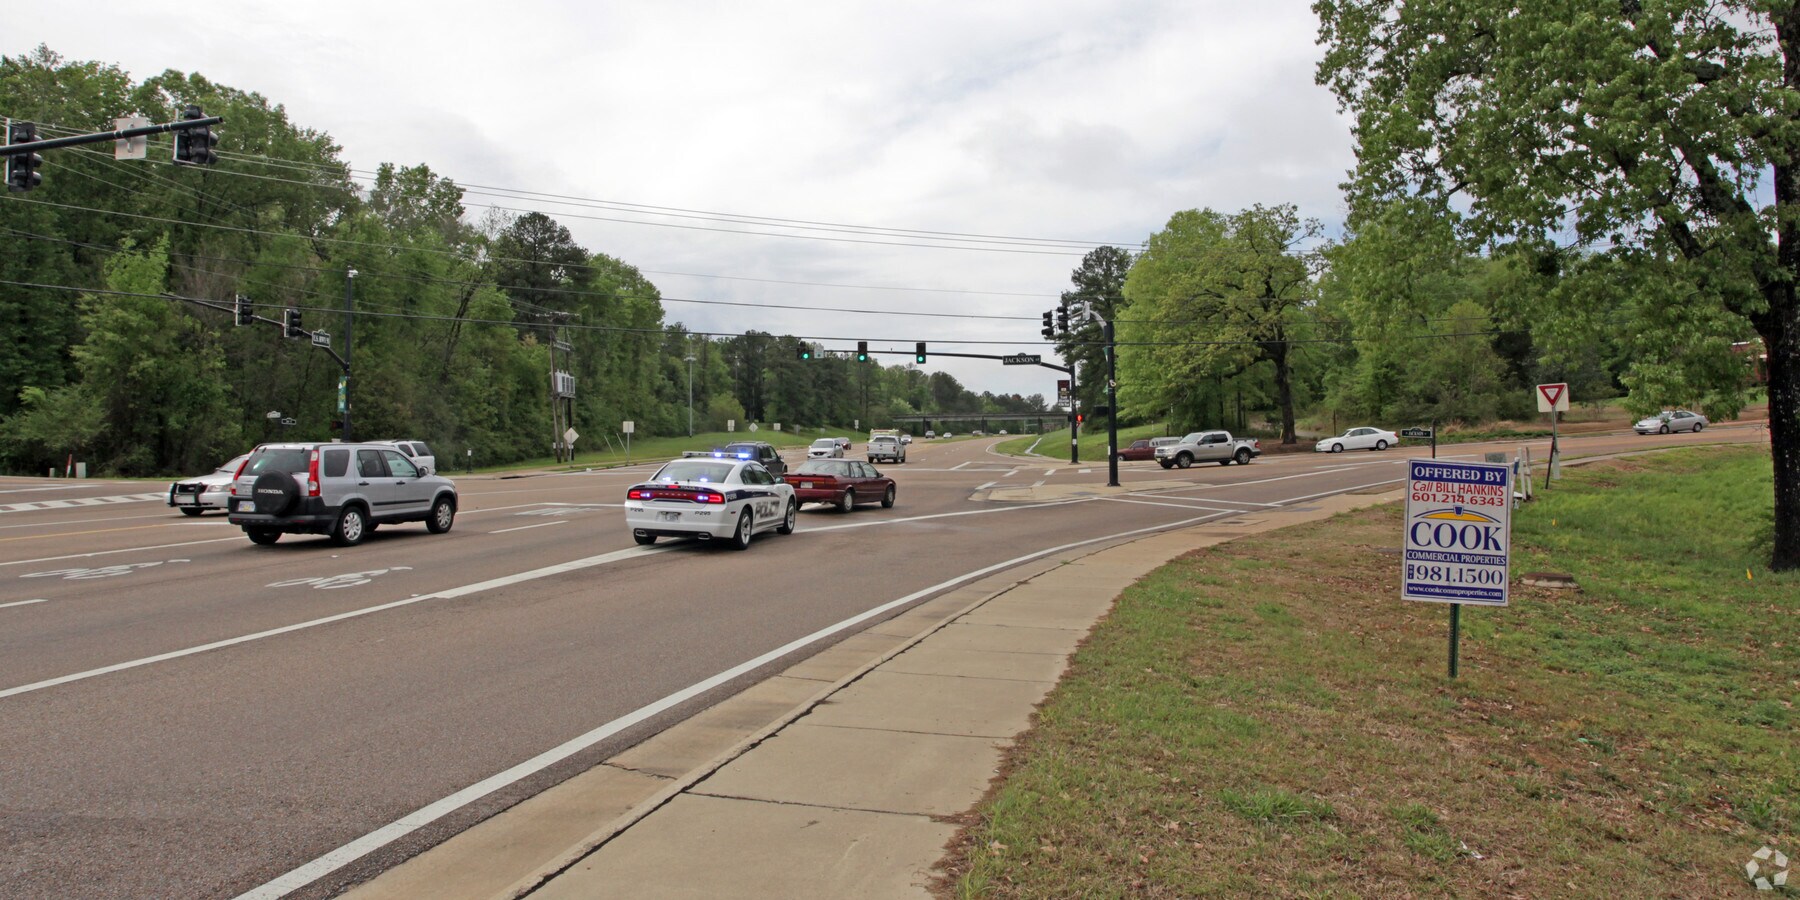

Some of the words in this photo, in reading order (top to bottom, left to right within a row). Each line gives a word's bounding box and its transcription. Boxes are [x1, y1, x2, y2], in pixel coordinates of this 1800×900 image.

[1414, 466, 1481, 480] OFFERED
[1485, 471, 1503, 482] BY
[1413, 481, 1433, 492] Call
[1436, 482, 1456, 494] BILL
[1458, 484, 1504, 497] HANKINS
[1411, 492, 1504, 507] 601.214.6343
[1411, 522, 1502, 551] COOK
[1407, 550, 1460, 563] COMMERCIAL
[1461, 554, 1506, 565] PROPERTIES
[1416, 564, 1503, 585] 981.1500
[1408, 585, 1502, 597] www.cookcommproperties.com
